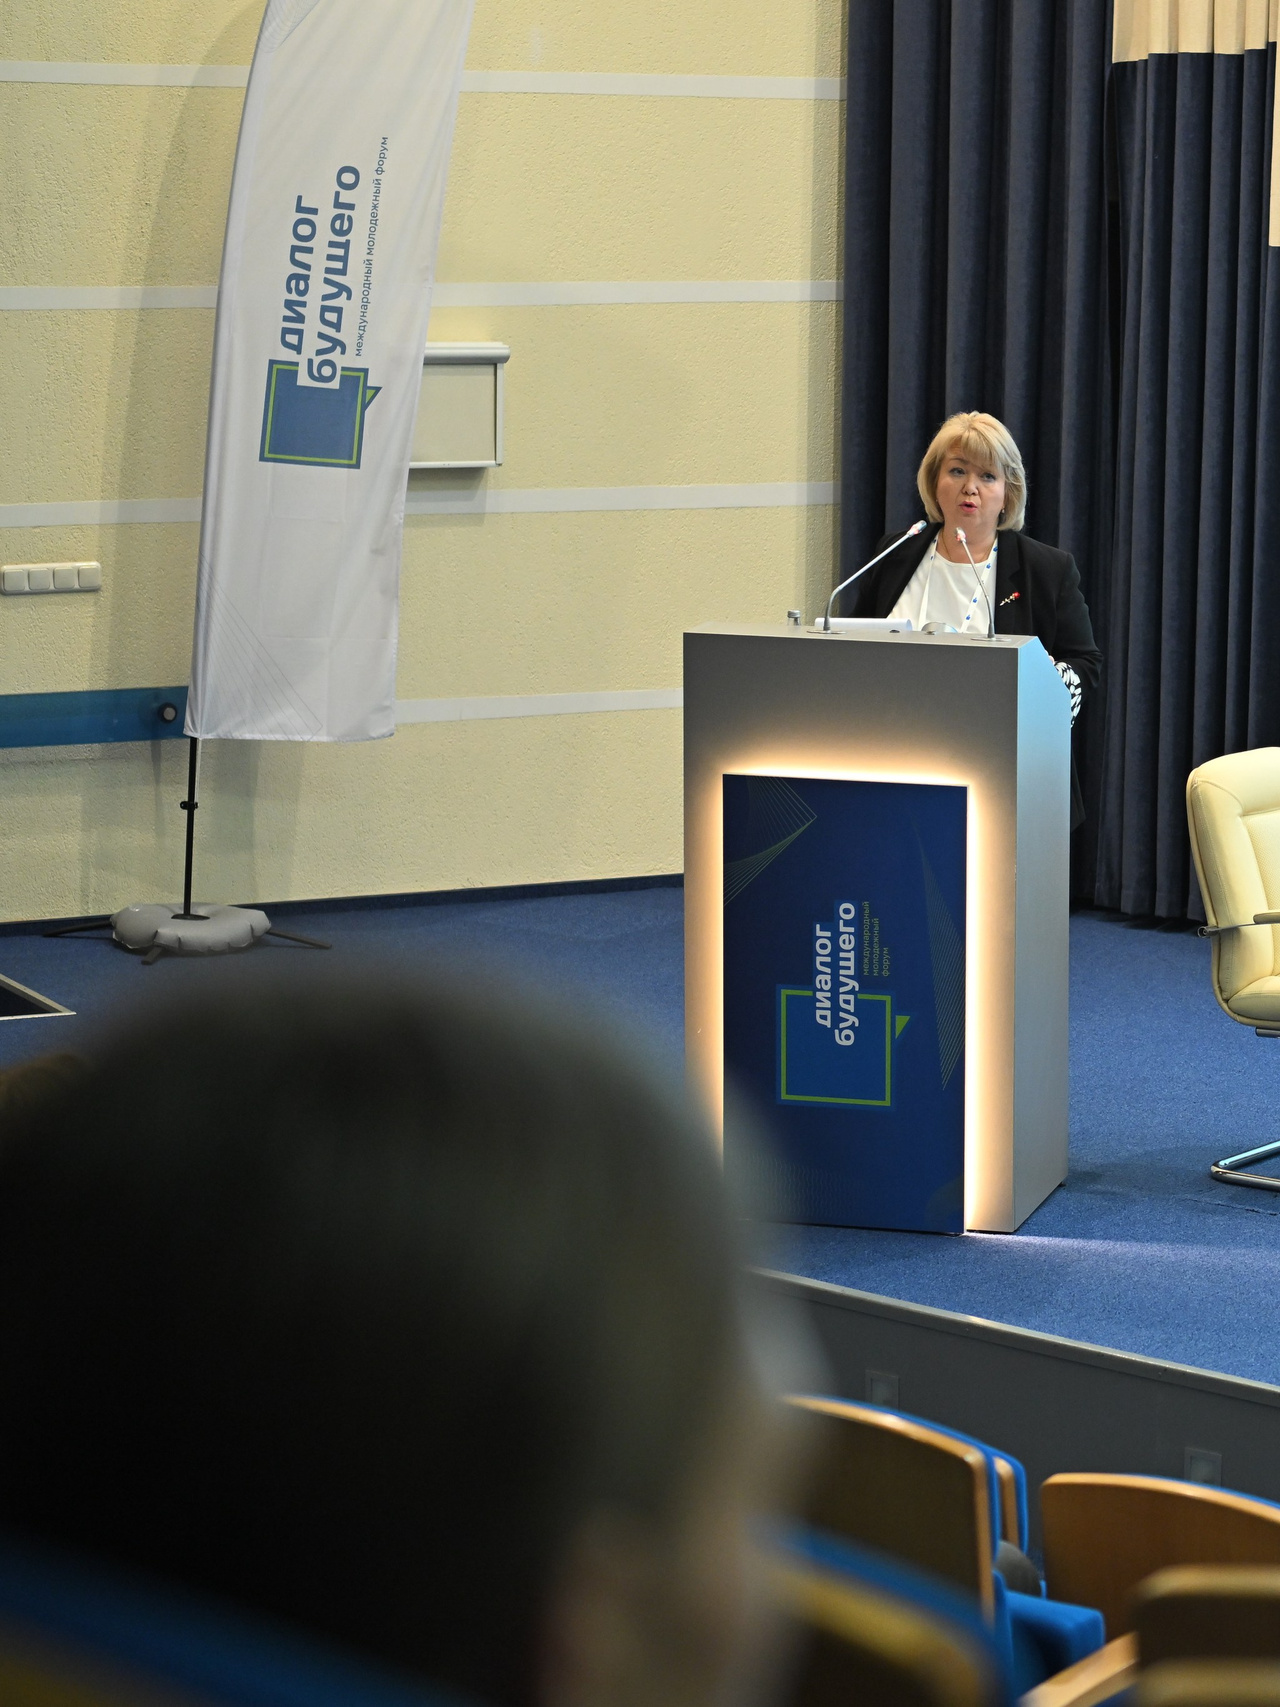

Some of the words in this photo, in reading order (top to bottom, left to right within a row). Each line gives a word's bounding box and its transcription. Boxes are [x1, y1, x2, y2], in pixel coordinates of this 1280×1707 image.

[280, 195, 319, 355] диалог
[307, 165, 361, 384] будущего
[354, 259, 374, 357] международный
[365, 178, 382, 256] молодежный
[374, 137, 389, 175] форум
[815, 923, 832, 1028] диалог
[834, 902, 860, 1046] будущего
[862, 901, 871, 976] международный
[871, 917, 880, 976] молодежный
[881, 947, 891, 977] форум
